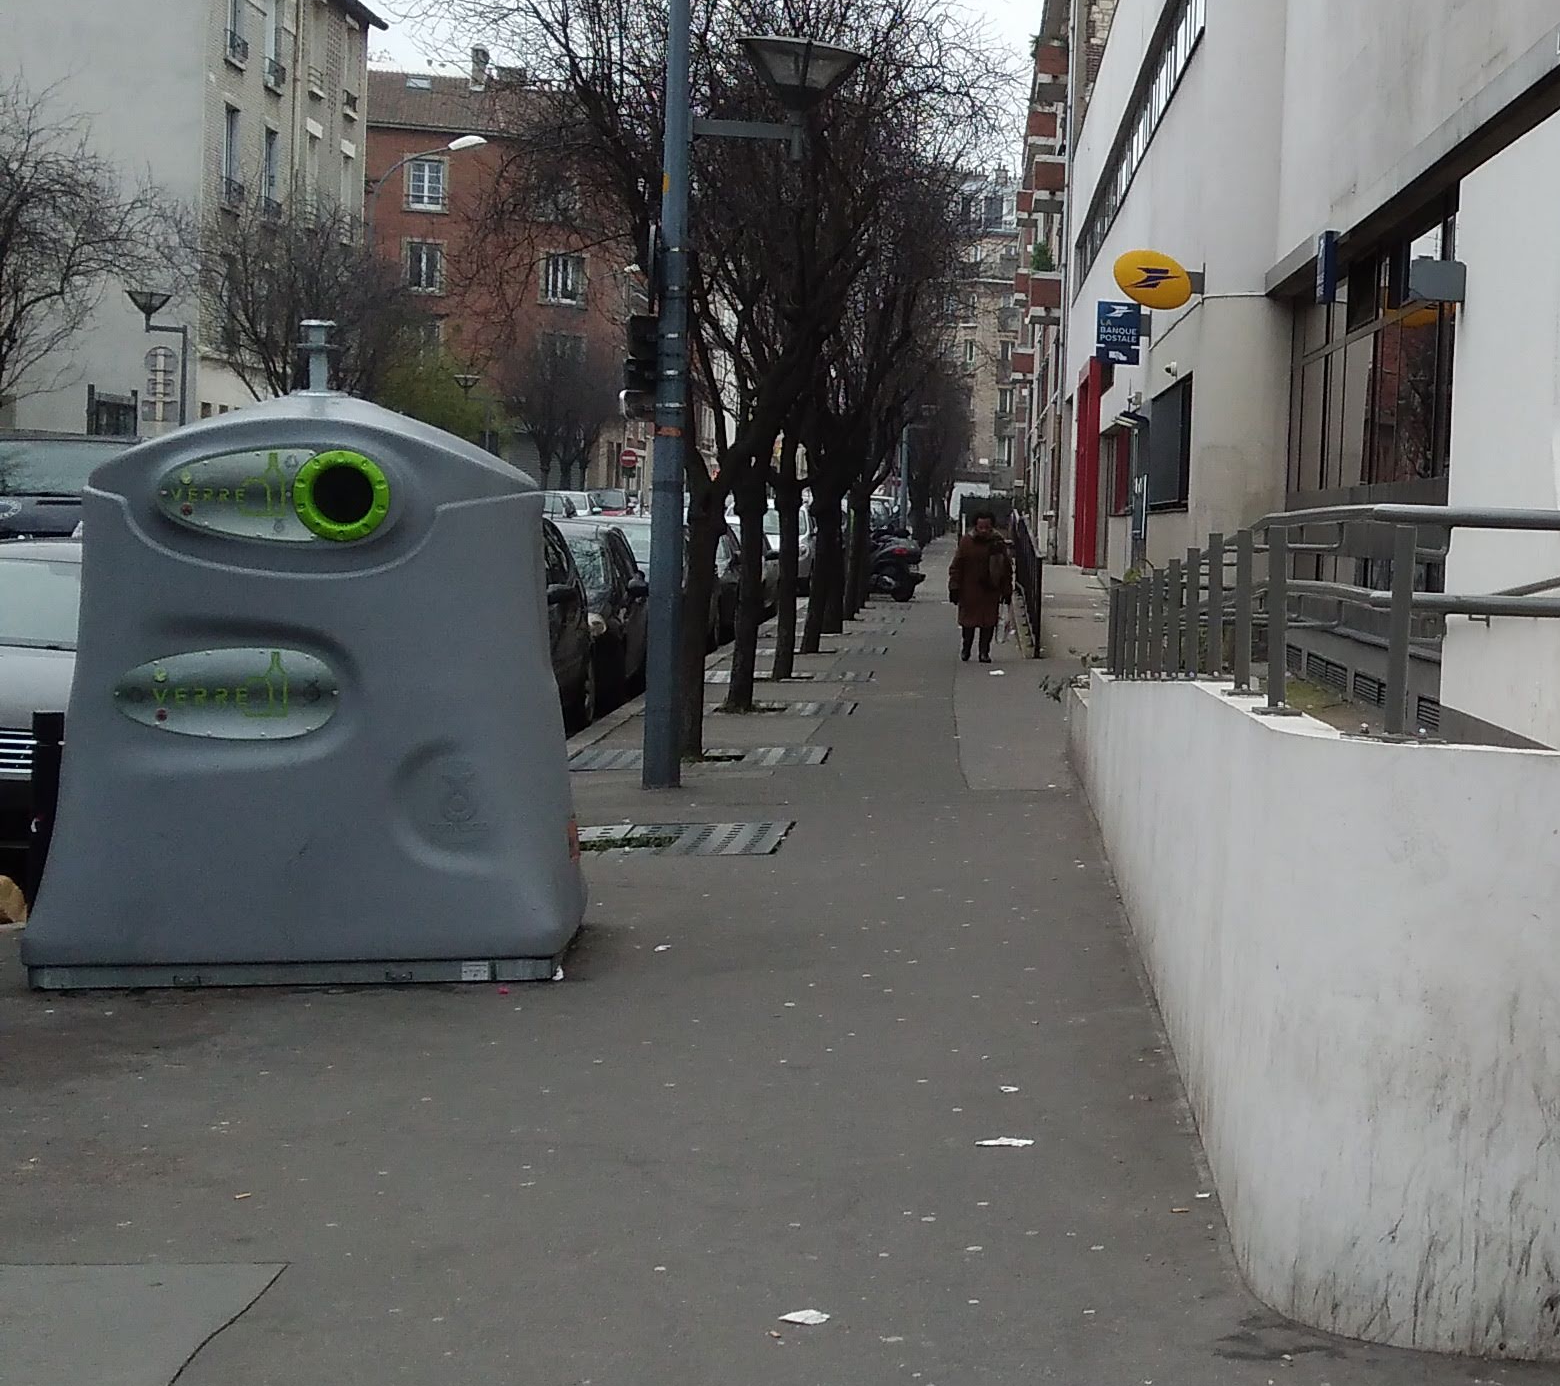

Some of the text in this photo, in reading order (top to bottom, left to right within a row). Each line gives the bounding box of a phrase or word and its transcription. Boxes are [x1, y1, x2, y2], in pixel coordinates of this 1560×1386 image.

[1100, 318, 1112, 326] LA
[1100, 326, 1137, 335] BANQUE
[1100, 334, 1137, 343] POSTALE
[169, 486, 247, 504] VERRE
[152, 687, 249, 706] VERRE
